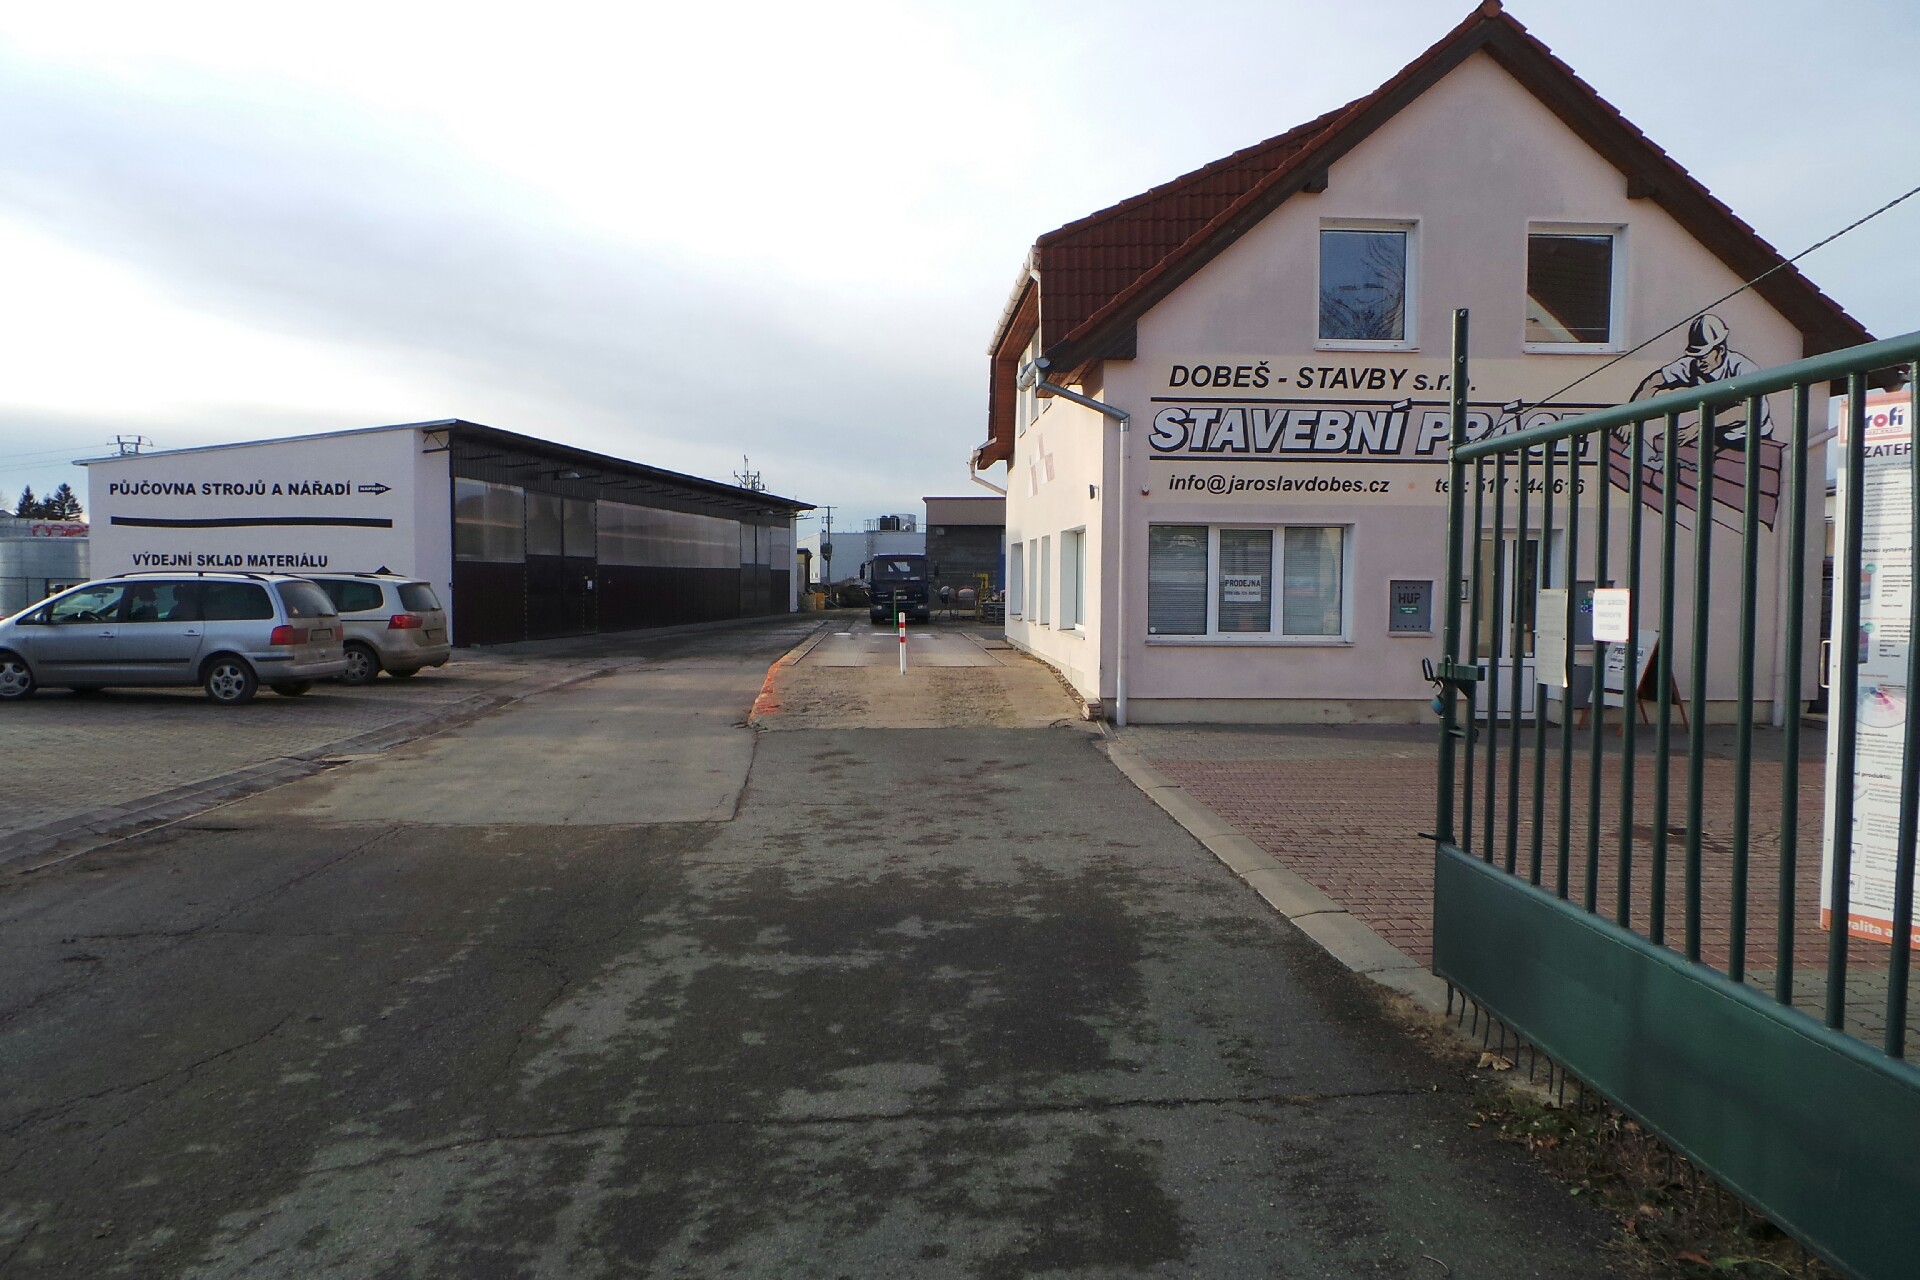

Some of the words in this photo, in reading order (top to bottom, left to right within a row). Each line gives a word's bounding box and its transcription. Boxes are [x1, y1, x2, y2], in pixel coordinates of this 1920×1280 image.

[1168, 361, 1271, 388] DOBEŠ
[1296, 367, 1409, 390] STAVBY
[1412, 373, 1477, 391] s.r..
[1148, 397, 1413, 455] STAVEBNÍ
[109, 479, 197, 496] PŮJČOVNA
[202, 479, 266, 496] STROJŮ
[271, 483, 284, 496] A
[288, 480, 351, 496] NÁŘADÍ
[1168, 475, 1391, 495] info@jaroslavdobes.cz
[1434, 478, 1470, 493] te:
[1553, 478, 1585, 495] 66
[132, 551, 193, 567] VÝDEJNÍ
[197, 554, 243, 567] SKLAD
[247, 552, 328, 568] MATERIÁLU
[1224, 579, 1261, 587] PRODEJNA
[1398, 592, 1421, 604] HUP
